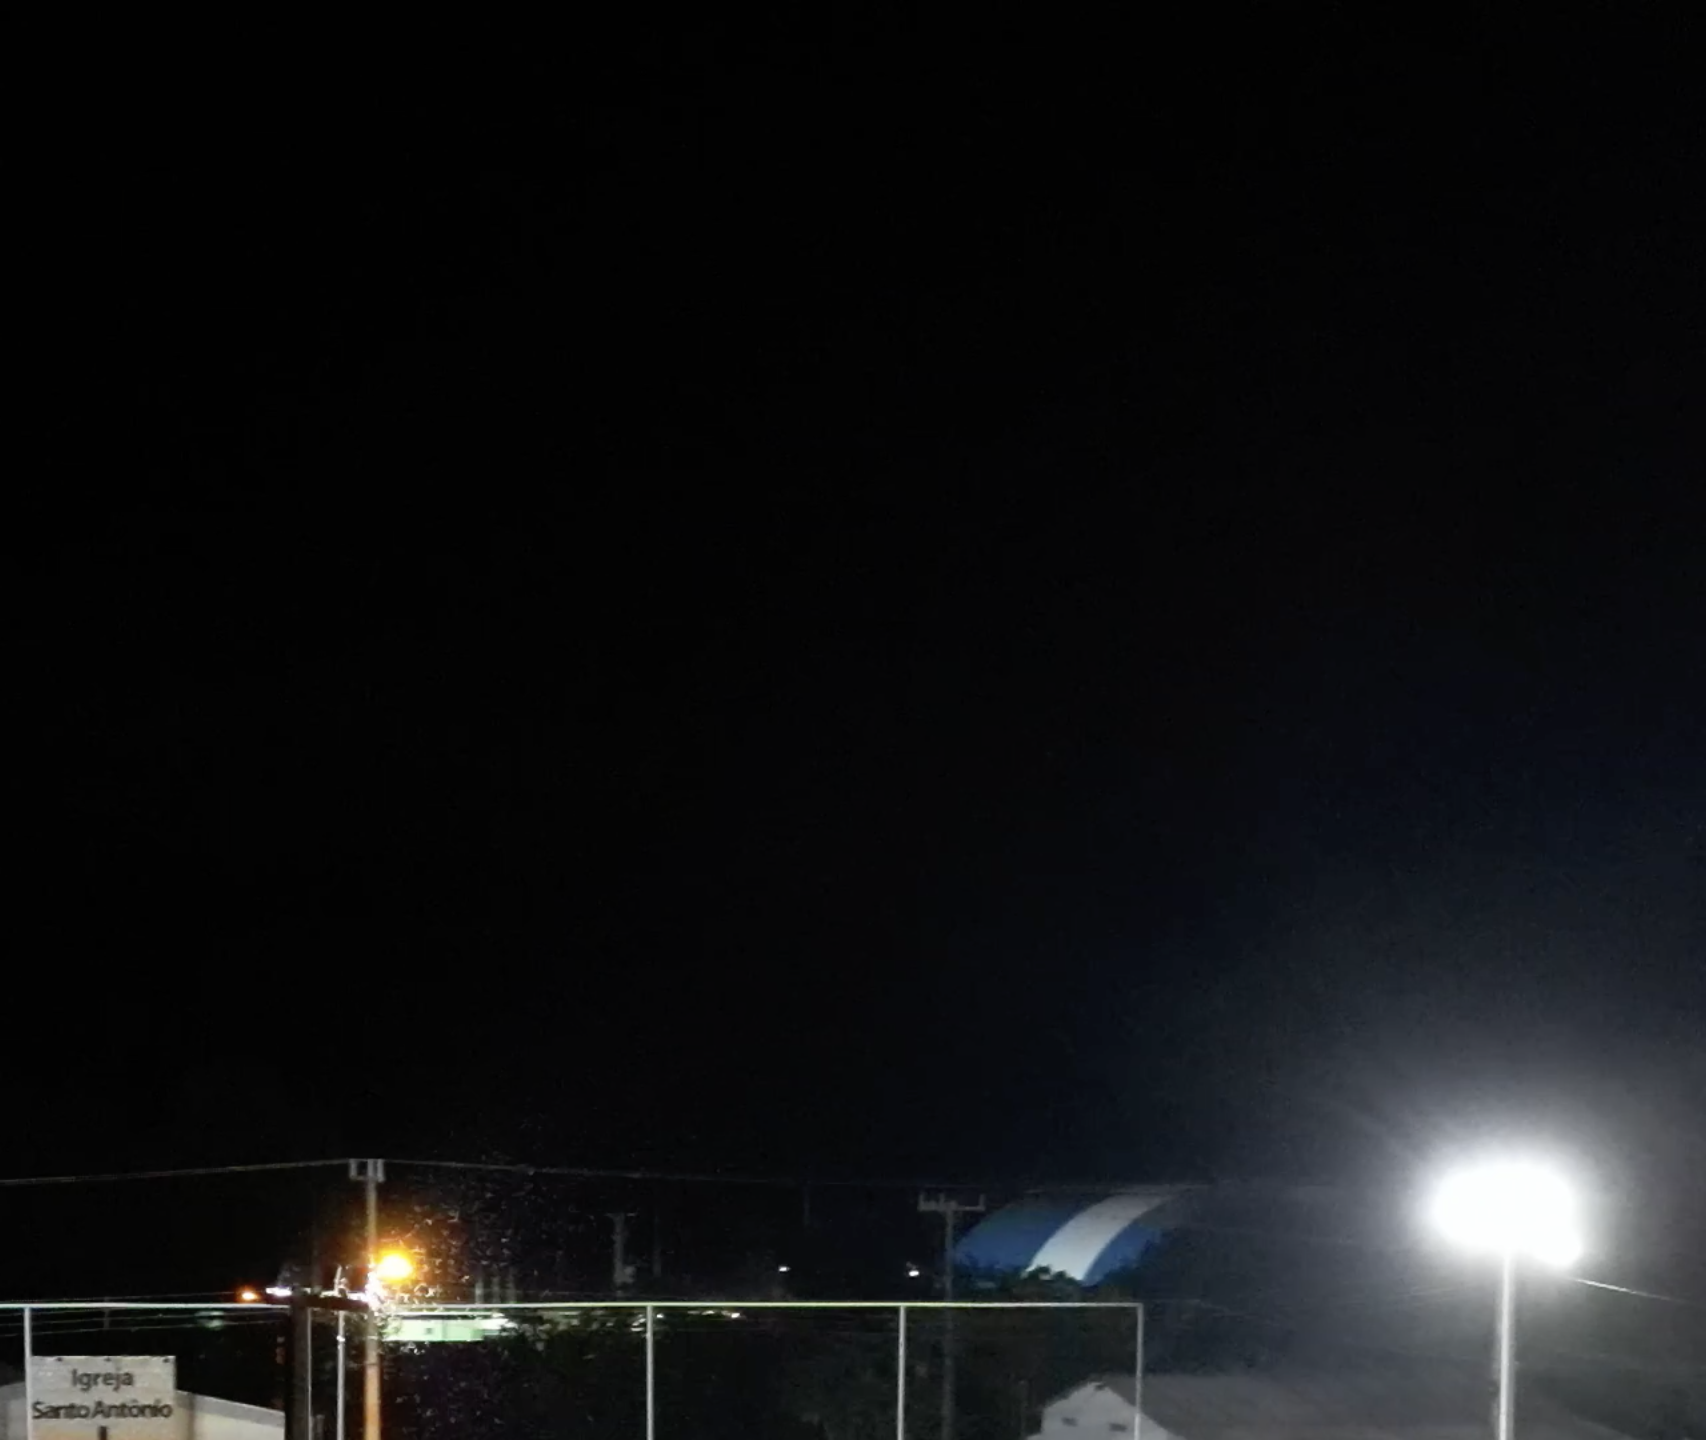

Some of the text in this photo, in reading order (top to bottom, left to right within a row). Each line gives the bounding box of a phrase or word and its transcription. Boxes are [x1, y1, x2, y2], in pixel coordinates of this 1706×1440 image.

[71, 1368, 134, 1392] Igreja
[32, 1399, 173, 1419] Santo Antônio
